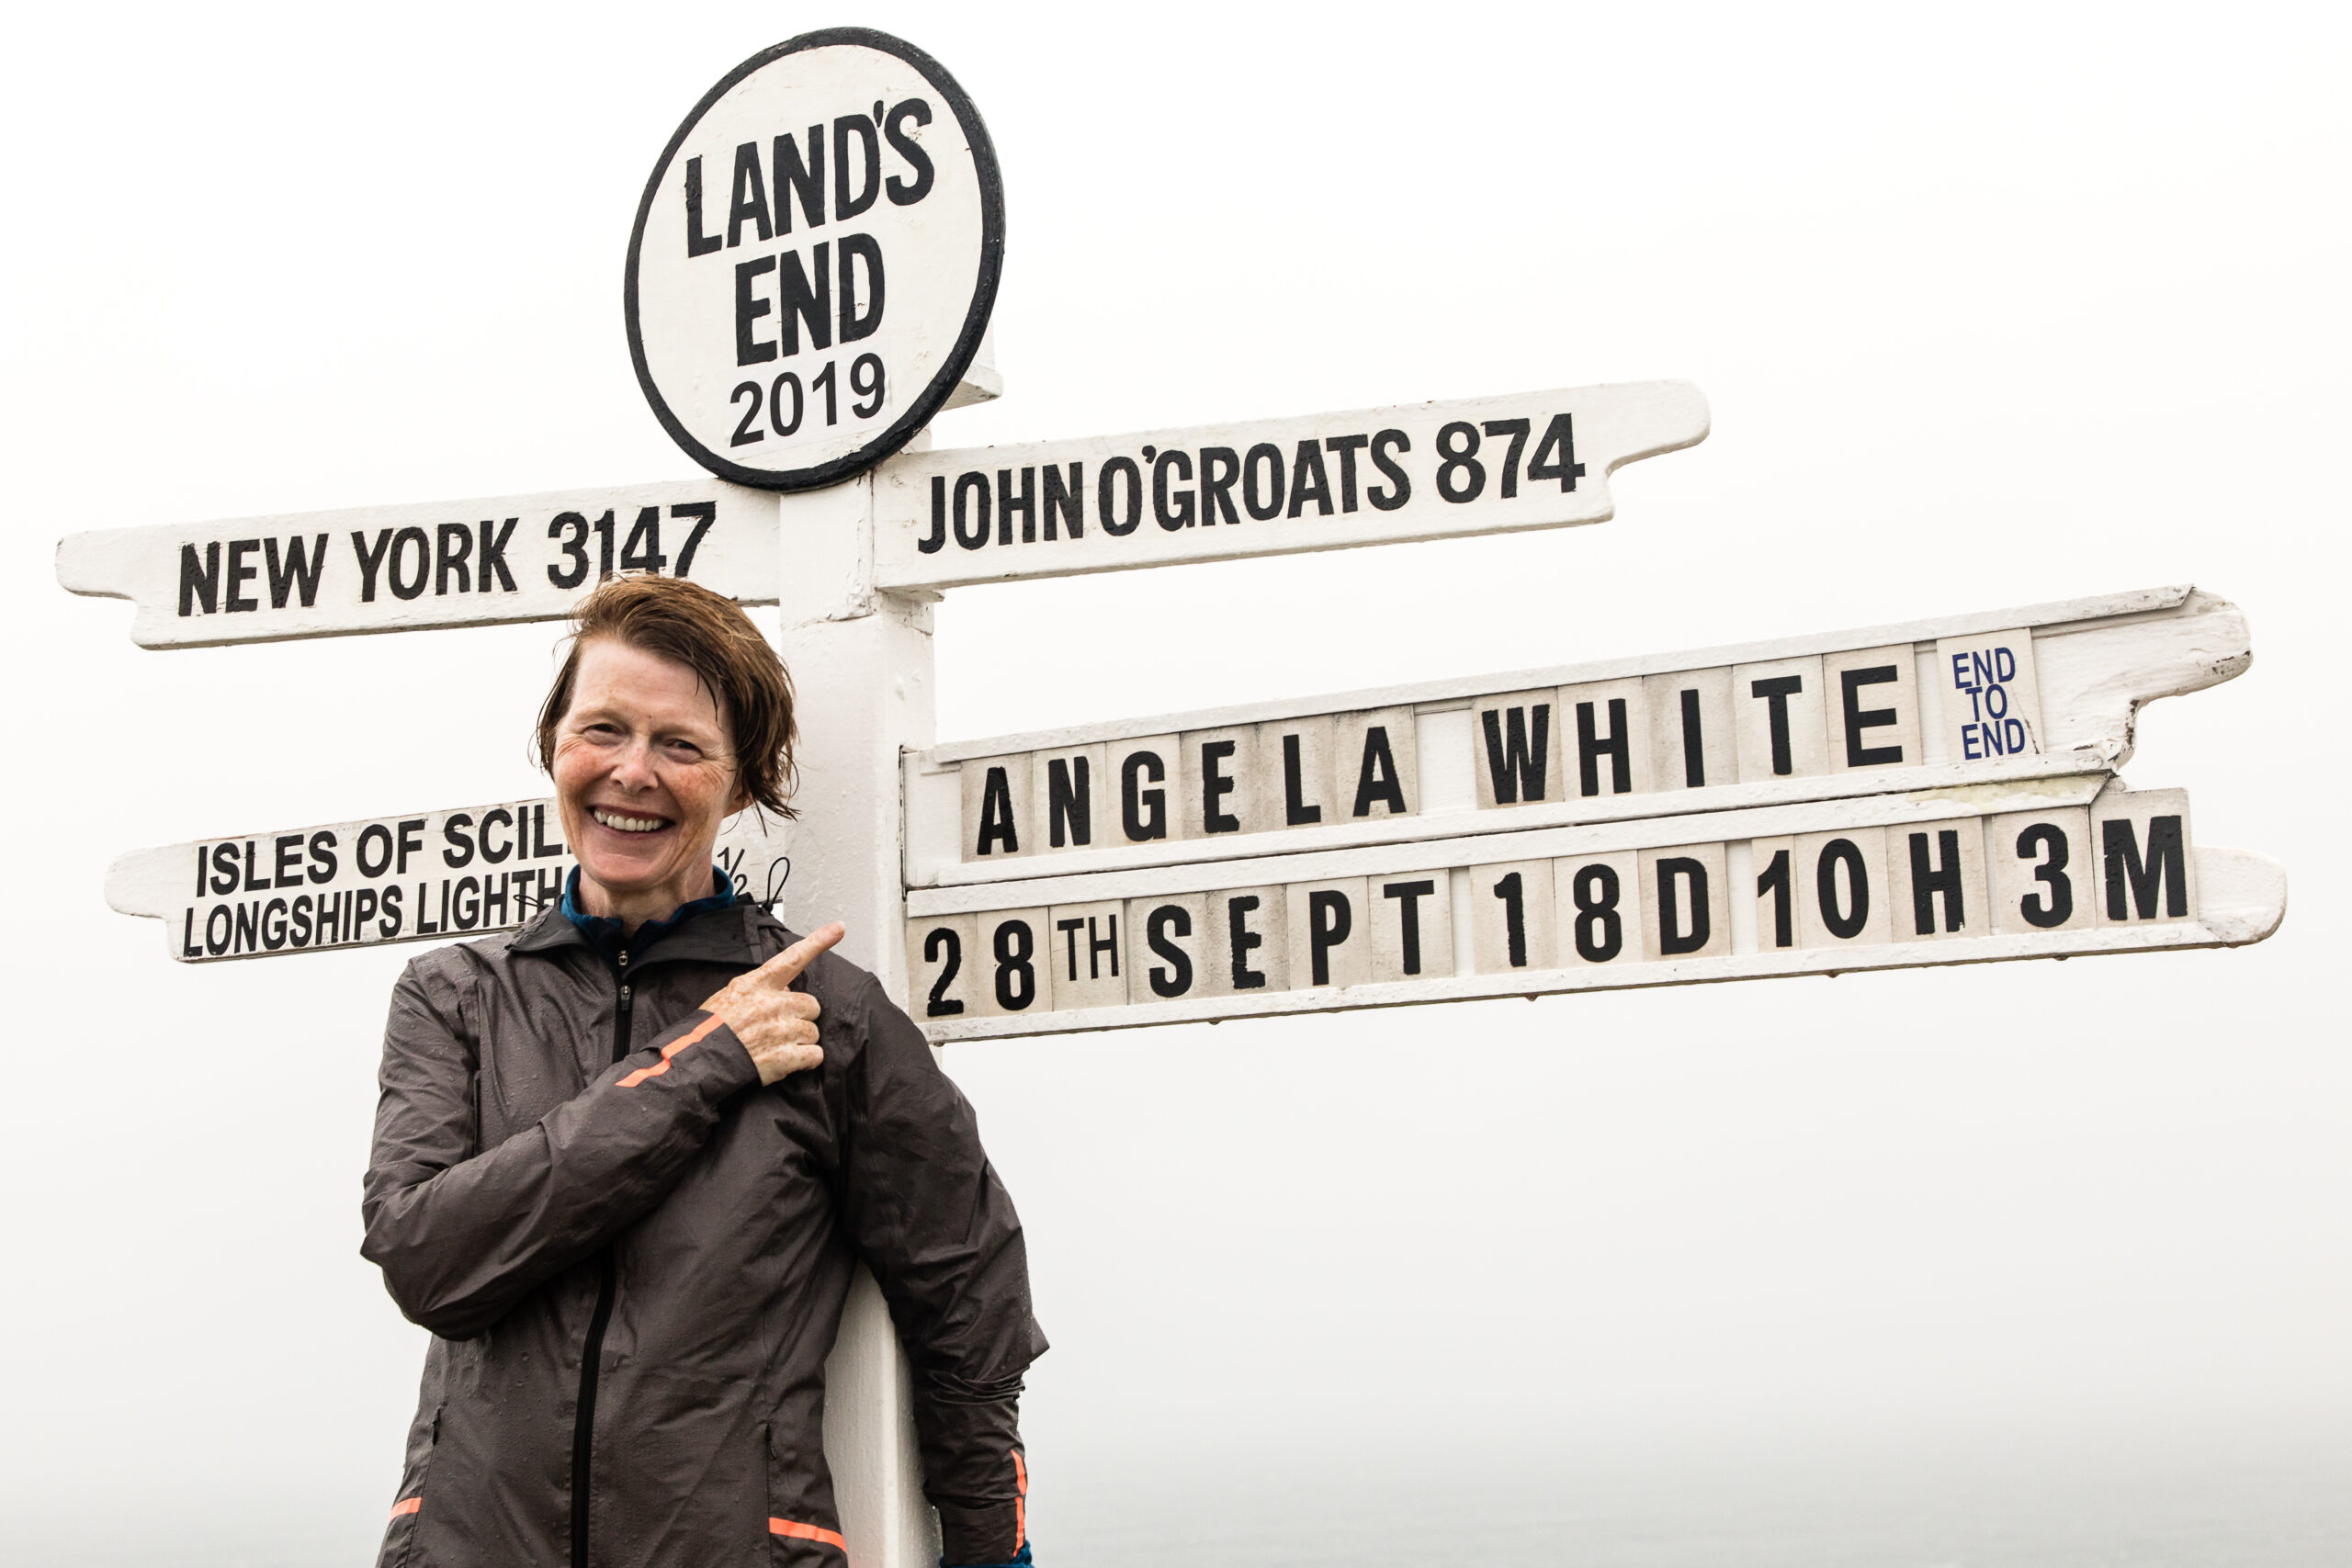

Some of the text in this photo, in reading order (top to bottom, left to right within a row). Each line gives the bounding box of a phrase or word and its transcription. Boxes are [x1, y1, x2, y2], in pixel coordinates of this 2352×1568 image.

[684, 98, 934, 257] LAND'S
[736, 233, 885, 366] END
[730, 353, 885, 447] 2019
[919, 413, 1585, 554] JOHN O'GROATS 874
[178, 501, 716, 616] NEW YORK 3147
[1952, 648, 2015, 689] END
[1965, 684, 2007, 722] TO
[977, 665, 1903, 855] ANGELA WHITE
[1962, 719, 2024, 760] END
[197, 805, 571, 897] ISLES OF SCIL
[184, 886, 402, 956] LONGSHIPS
[1148, 880, 1434, 998] SEPT
[1494, 857, 1710, 967] 18D
[1758, 830, 1964, 947] 10H
[2017, 816, 2188, 928] 3M
